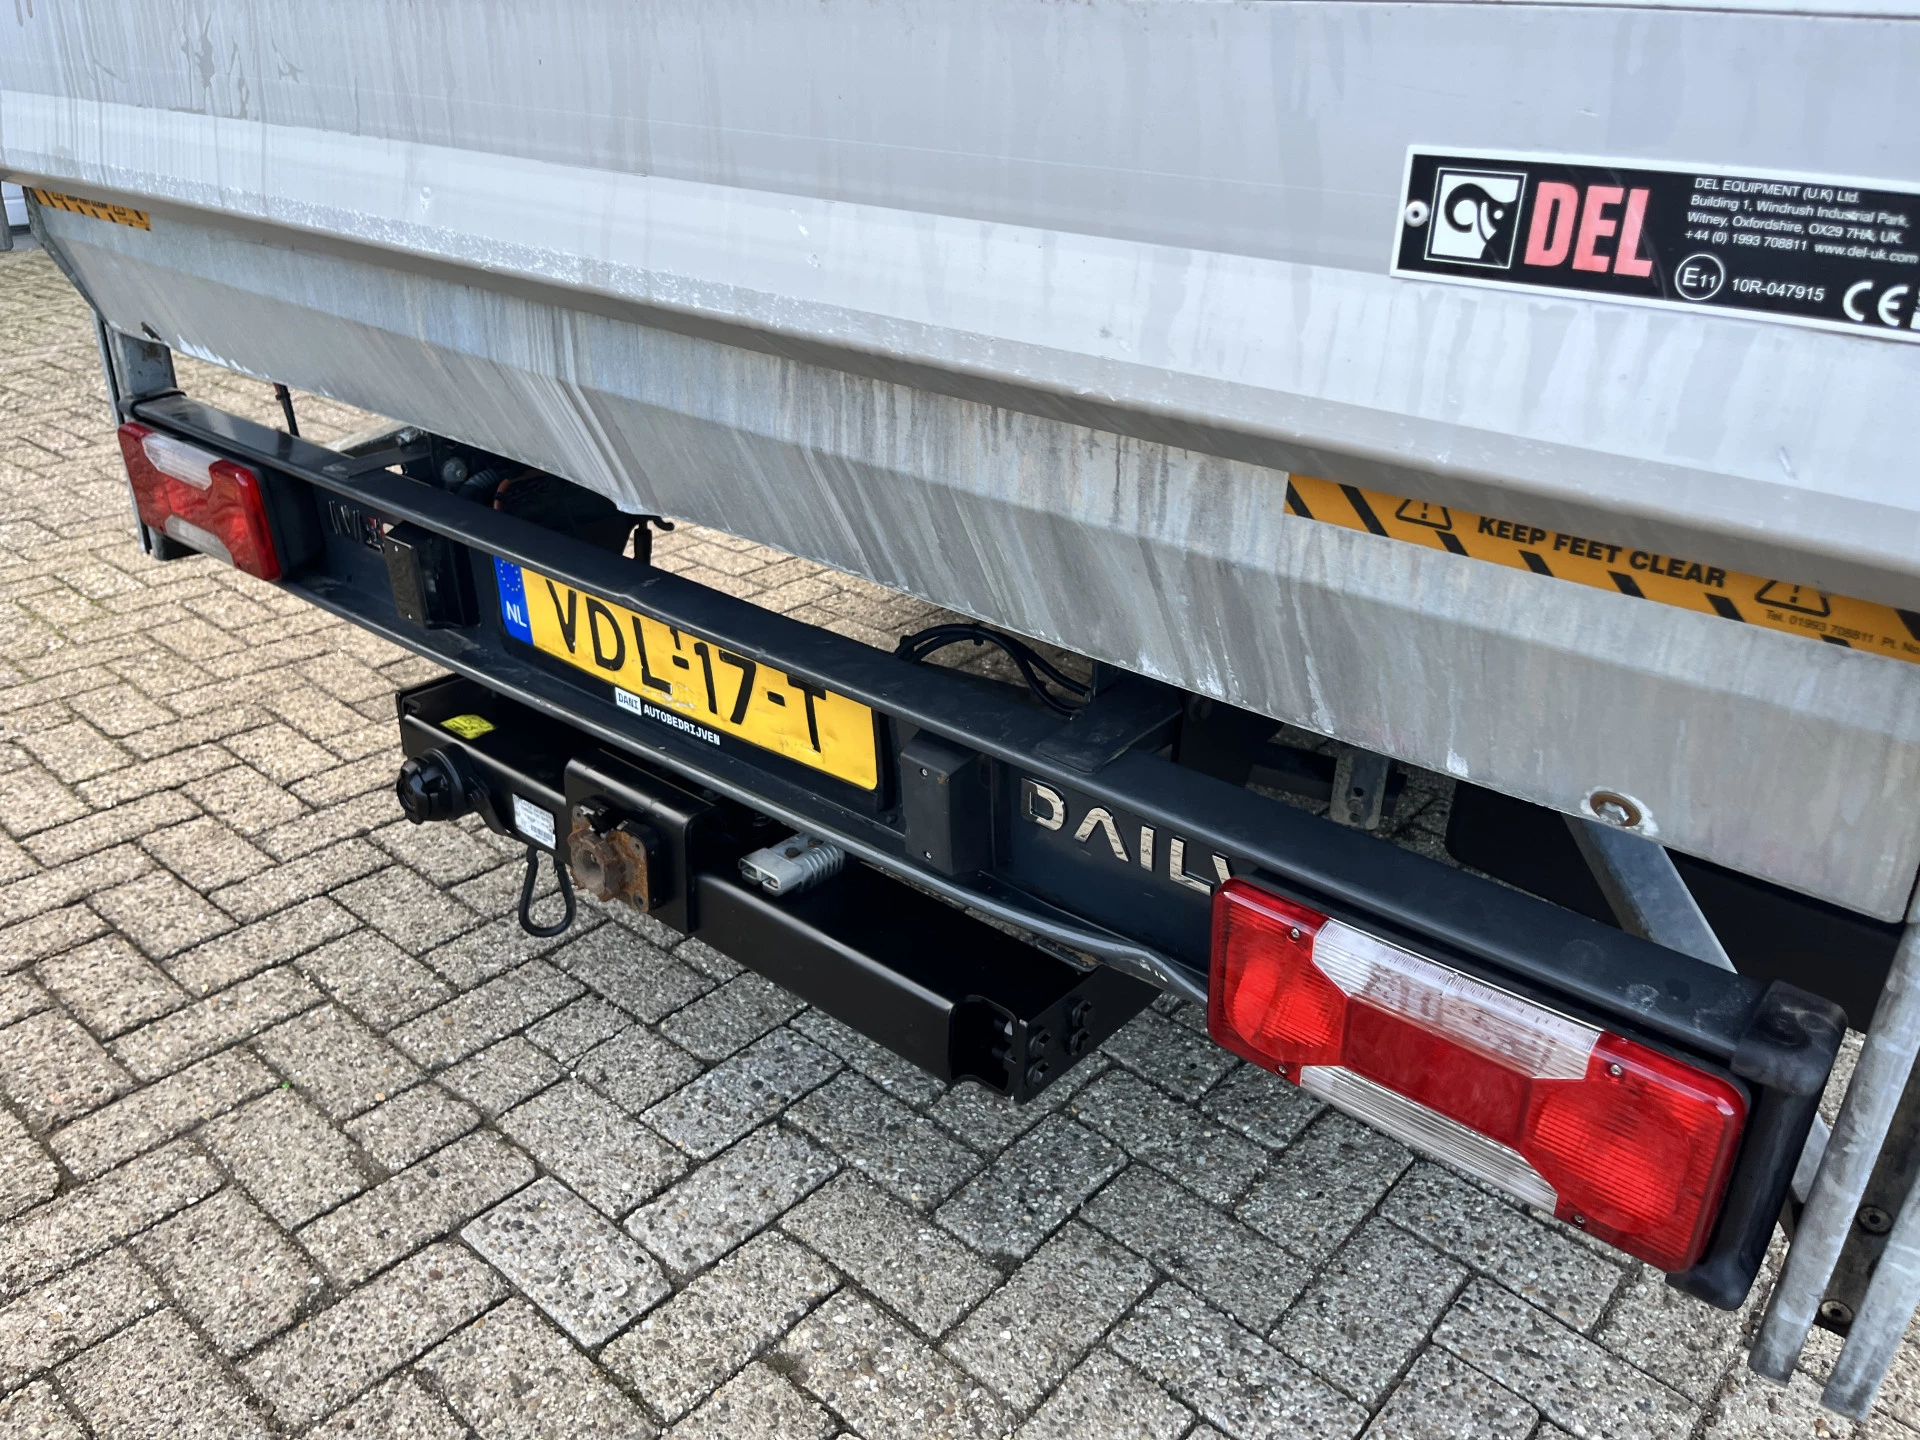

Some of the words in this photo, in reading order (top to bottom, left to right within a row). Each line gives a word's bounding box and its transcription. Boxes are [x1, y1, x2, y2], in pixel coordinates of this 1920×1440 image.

[1695, 178, 1720, 190] DEL
[1722, 180, 1801, 197] EQUIPMENT
[1836, 191, 1860, 203] Ltd.
[1691, 195, 1739, 212] Building
[1756, 201, 1814, 216] Windrush
[1817, 207, 1874, 222] Industrial
[1524, 181, 1654, 277] DEL
[1687, 212, 1729, 227] Witney,
[1732, 216, 1805, 235] Oxfordshire,
[1808, 223, 1844, 237] OX29
[1684, 230, 1709, 241] +44
[1711, 231, 1728, 244] (0)
[1732, 233, 1761, 246] 1993
[1764, 236, 1808, 251] 708811
[1814, 242, 1919, 264] www.del-uk.com
[1732, 278, 1826, 302] 10R-047915
[1477, 516, 1547, 545] KEEP
[1552, 532, 1624, 564] FEET
[1628, 550, 1727, 588] CLEAR
[506, 602, 527, 628] NL
[545, 578, 827, 754] VDL-17-T
[618, 692, 639, 710] DANI
[644, 703, 720, 746] AUTOBEDRIJVEN
